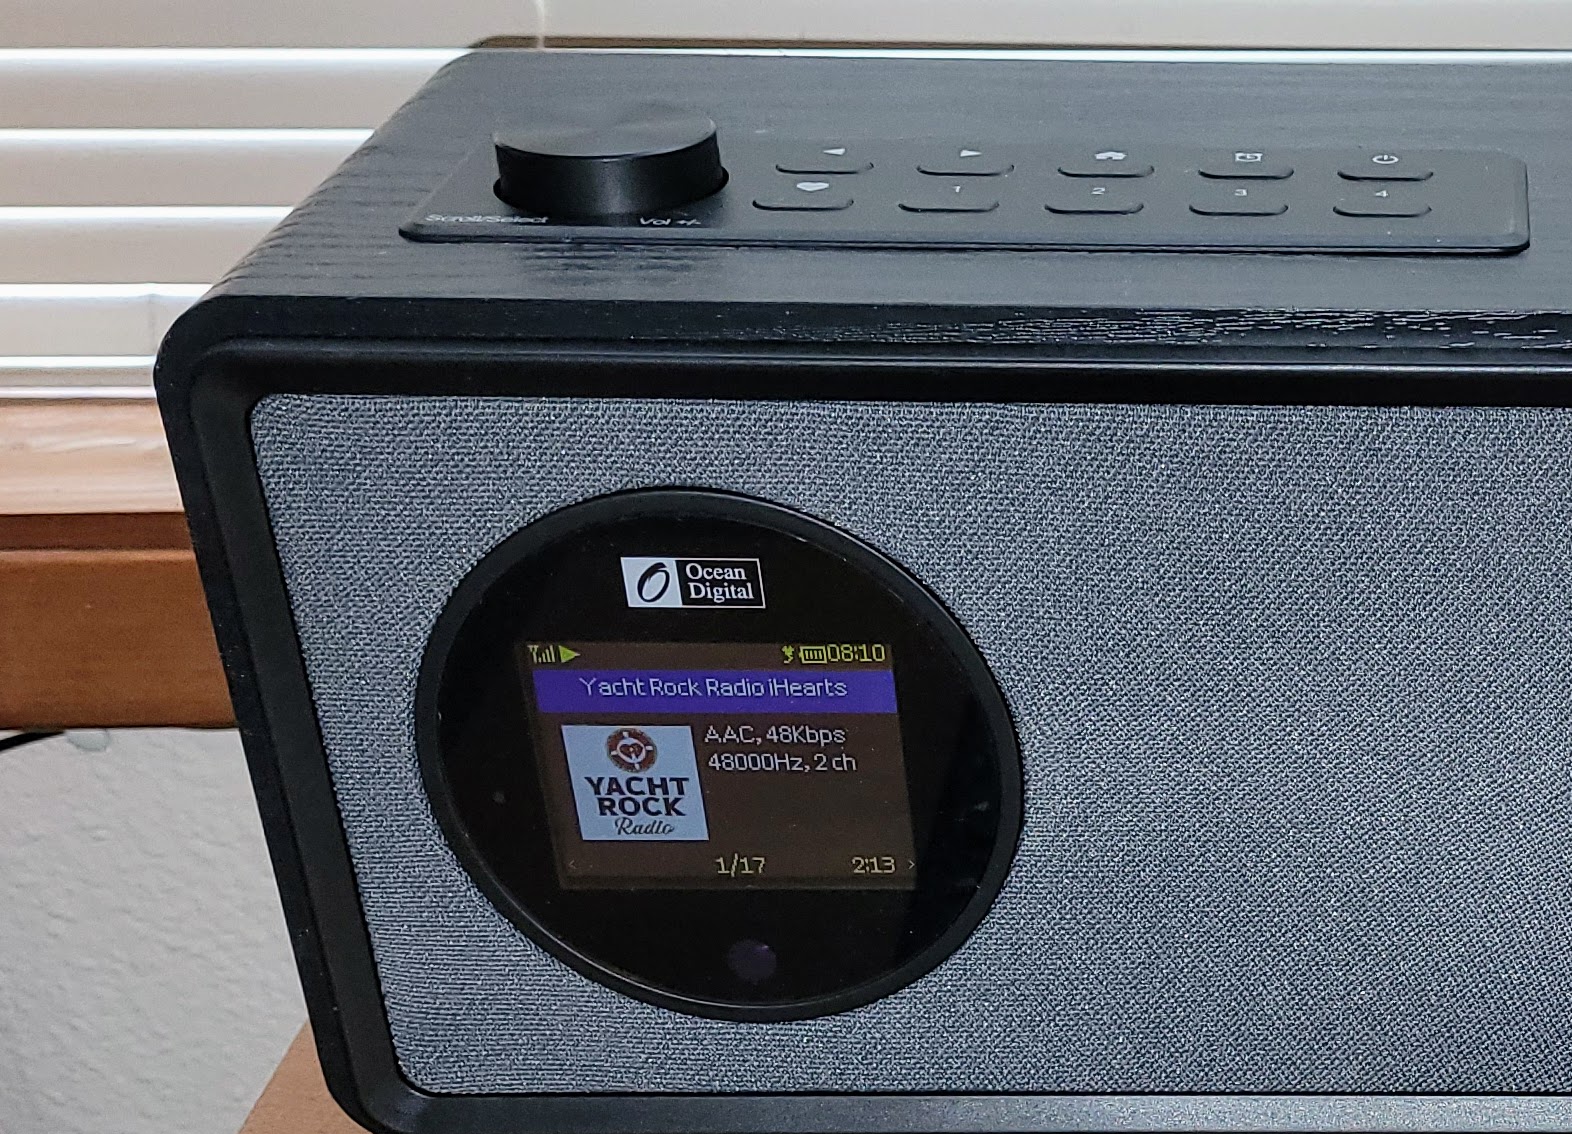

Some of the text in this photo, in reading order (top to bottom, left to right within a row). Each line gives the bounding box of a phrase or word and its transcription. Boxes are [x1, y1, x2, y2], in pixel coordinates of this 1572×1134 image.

[1091, 187, 1106, 195] 2
[639, 216, 671, 225] Vol
[685, 562, 746, 580] Ocean
[689, 581, 755, 603] Digital
[827, 644, 885, 662] 08:10
[579, 677, 848, 698] Yacht Rock Radio iHearts
[704, 725, 846, 747] AAC, 48Kbps
[708, 753, 858, 772] 48000Hz, 2 ch
[584, 776, 689, 796] YACHT
[597, 797, 687, 816] ROCK
[615, 817, 675, 836] Radio
[715, 853, 766, 877] 1/17
[851, 856, 896, 874] 2:13
